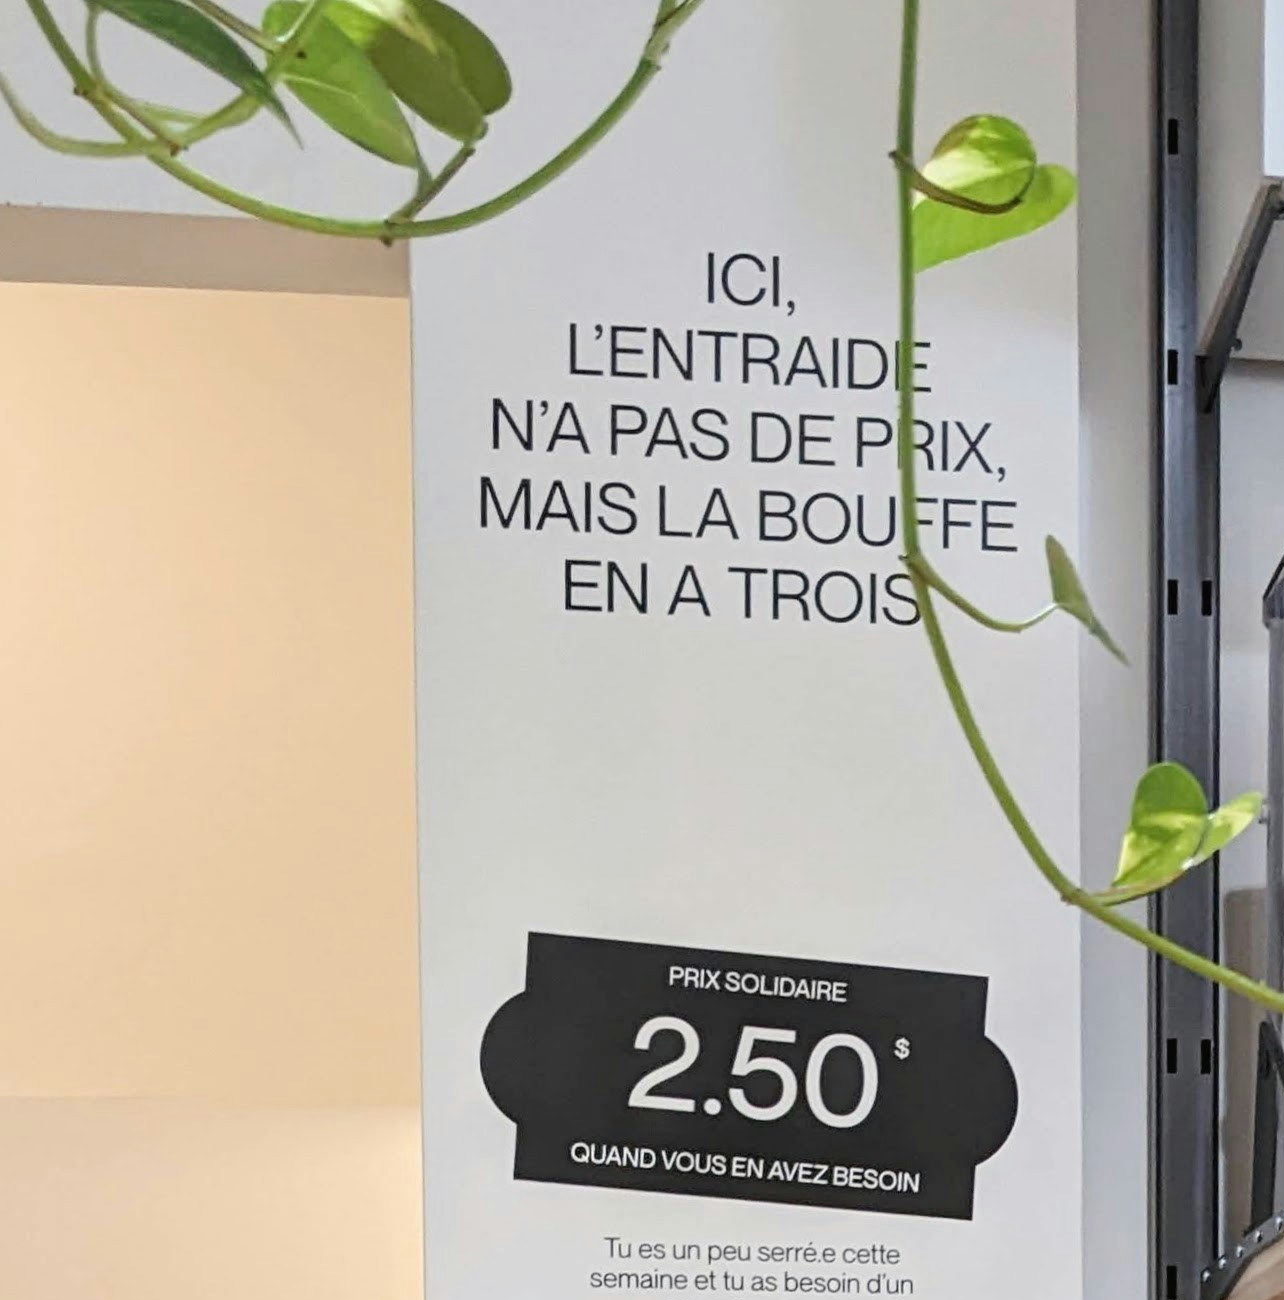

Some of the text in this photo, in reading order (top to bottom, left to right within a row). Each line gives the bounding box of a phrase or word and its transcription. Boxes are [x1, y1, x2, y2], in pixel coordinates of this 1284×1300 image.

[706, 252, 797, 316] ICI,
[568, 322, 932, 393] L'ENTRAIDE
[490, 397, 1007, 482] N'A PAS DE PRIX,
[479, 476, 638, 535] MAIS
[659, 484, 739, 540] LA
[563, 558, 921, 627] EN A TROIS
[668, 966, 848, 1003] PRIX SOLIDAIRE
[627, 1014, 879, 1129] 2.50
[569, 1141, 921, 1194] QUAND VOUS EN AVEZ BESOIN
[589, 1269, 914, 1296] semaine et tu as besoin d'un
[604, 1237, 901, 1268] Tu es un peu serré.e cette
